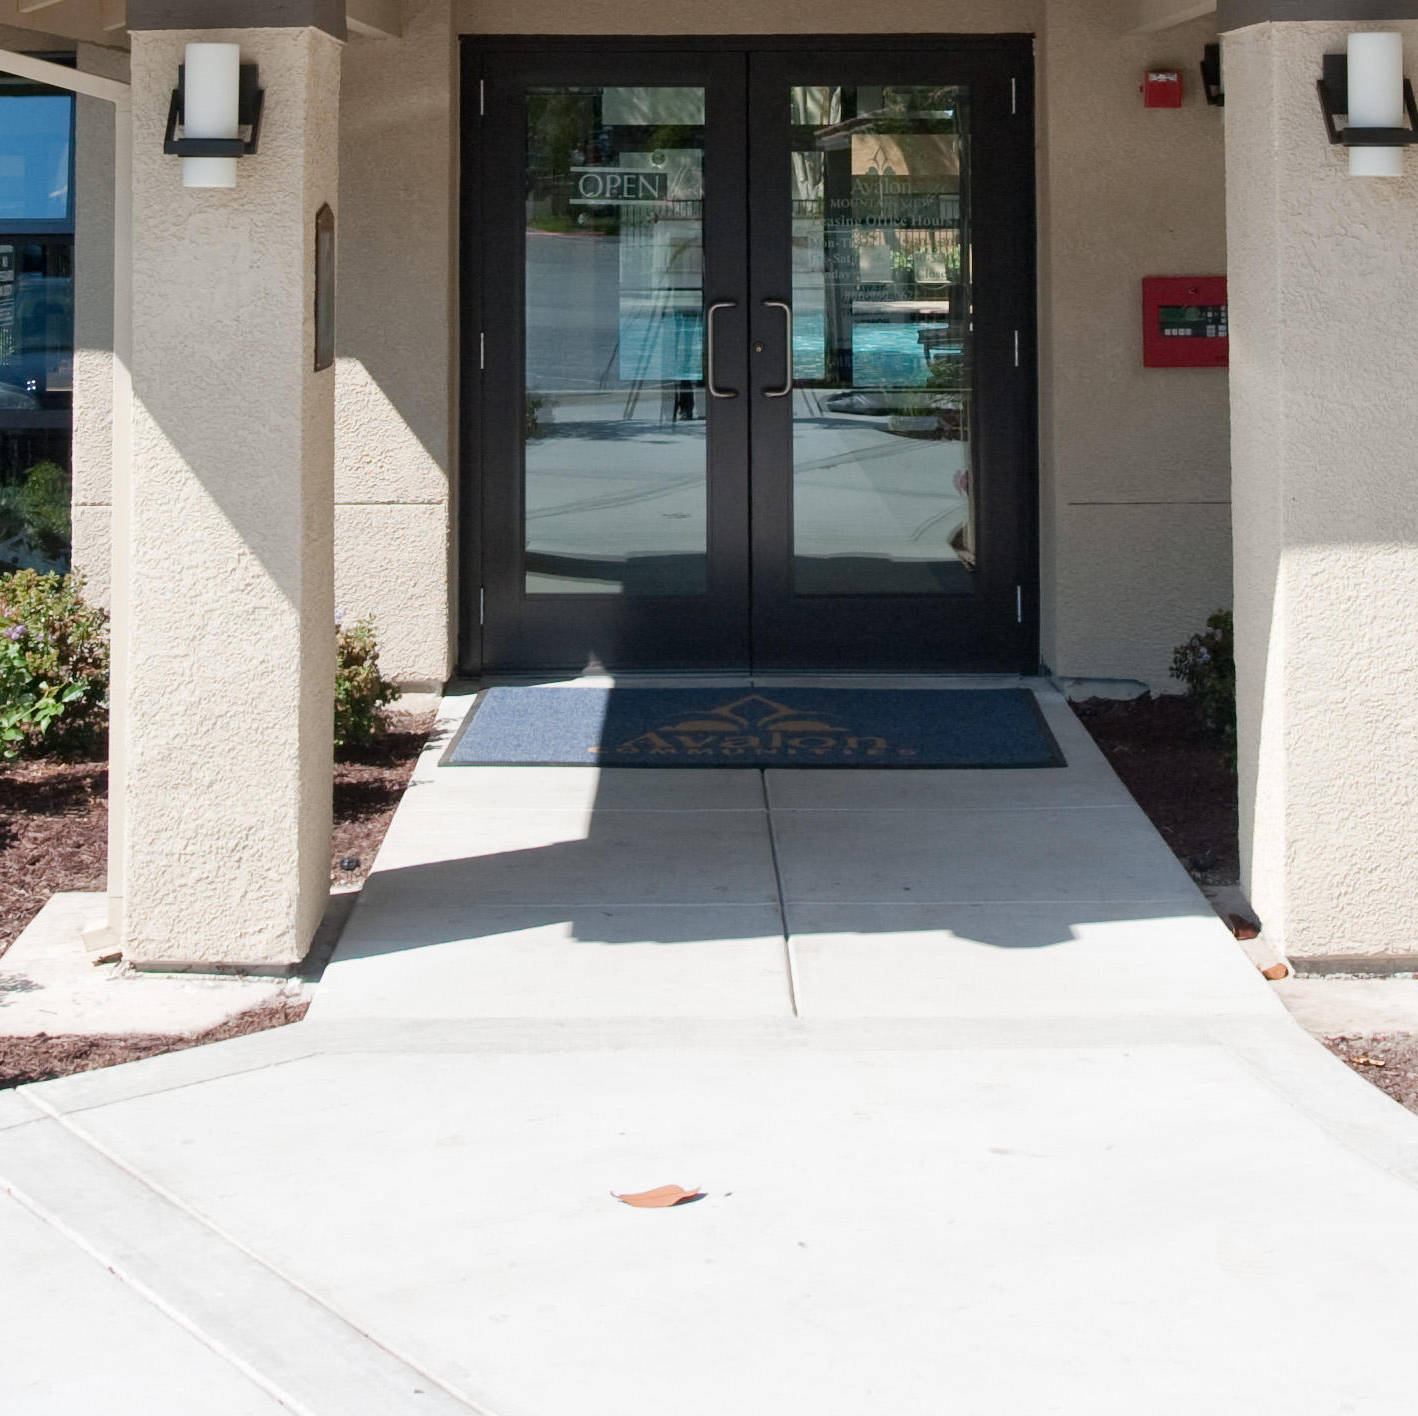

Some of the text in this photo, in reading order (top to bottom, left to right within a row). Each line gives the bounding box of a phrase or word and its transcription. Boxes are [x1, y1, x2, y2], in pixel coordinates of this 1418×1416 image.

[578, 173, 660, 198] OPEN
[850, 178, 912, 196] Avalon
[812, 215, 953, 228] Leasing Office Hours
[618, 731, 891, 749] Avalon
